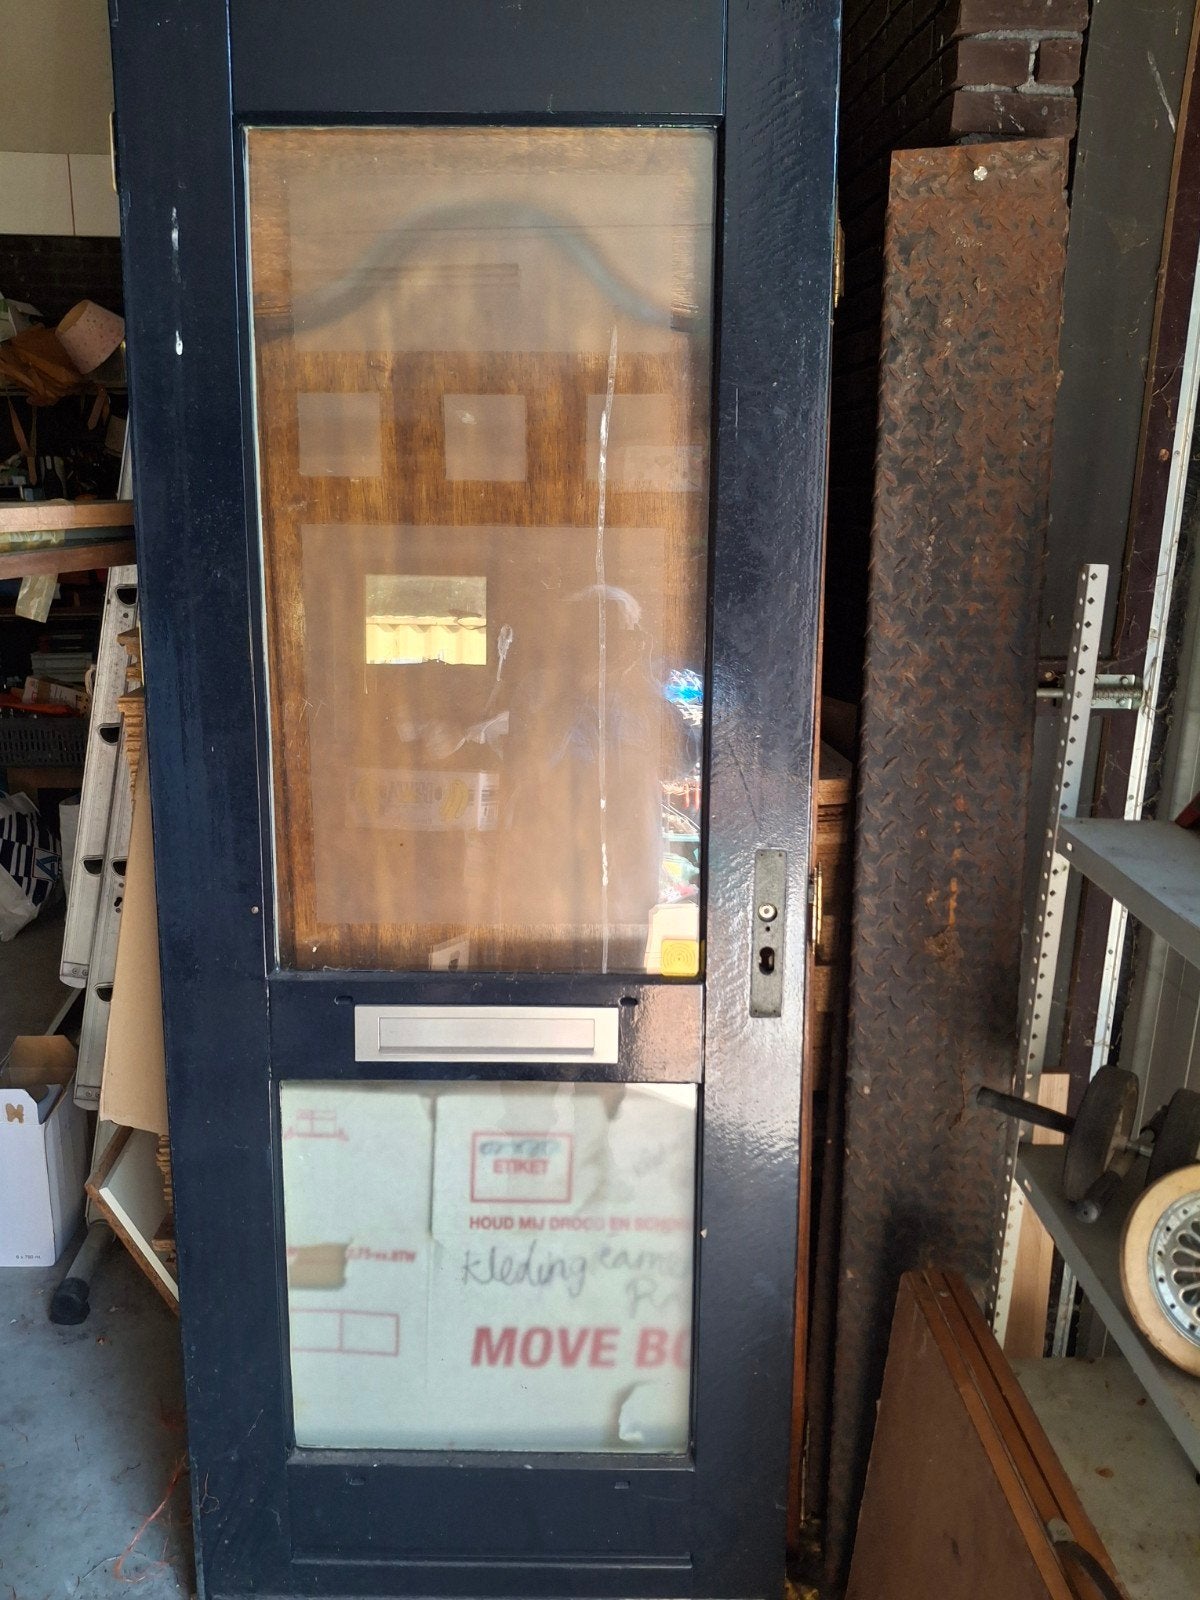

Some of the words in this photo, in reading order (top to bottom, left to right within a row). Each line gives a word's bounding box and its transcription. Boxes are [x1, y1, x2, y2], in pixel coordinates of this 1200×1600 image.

[493, 1158, 549, 1175] ETIKET
[469, 1215, 514, 1231] HOUD
[519, 1215, 544, 1231] MIJ
[470, 1325, 621, 1370] MOVE
